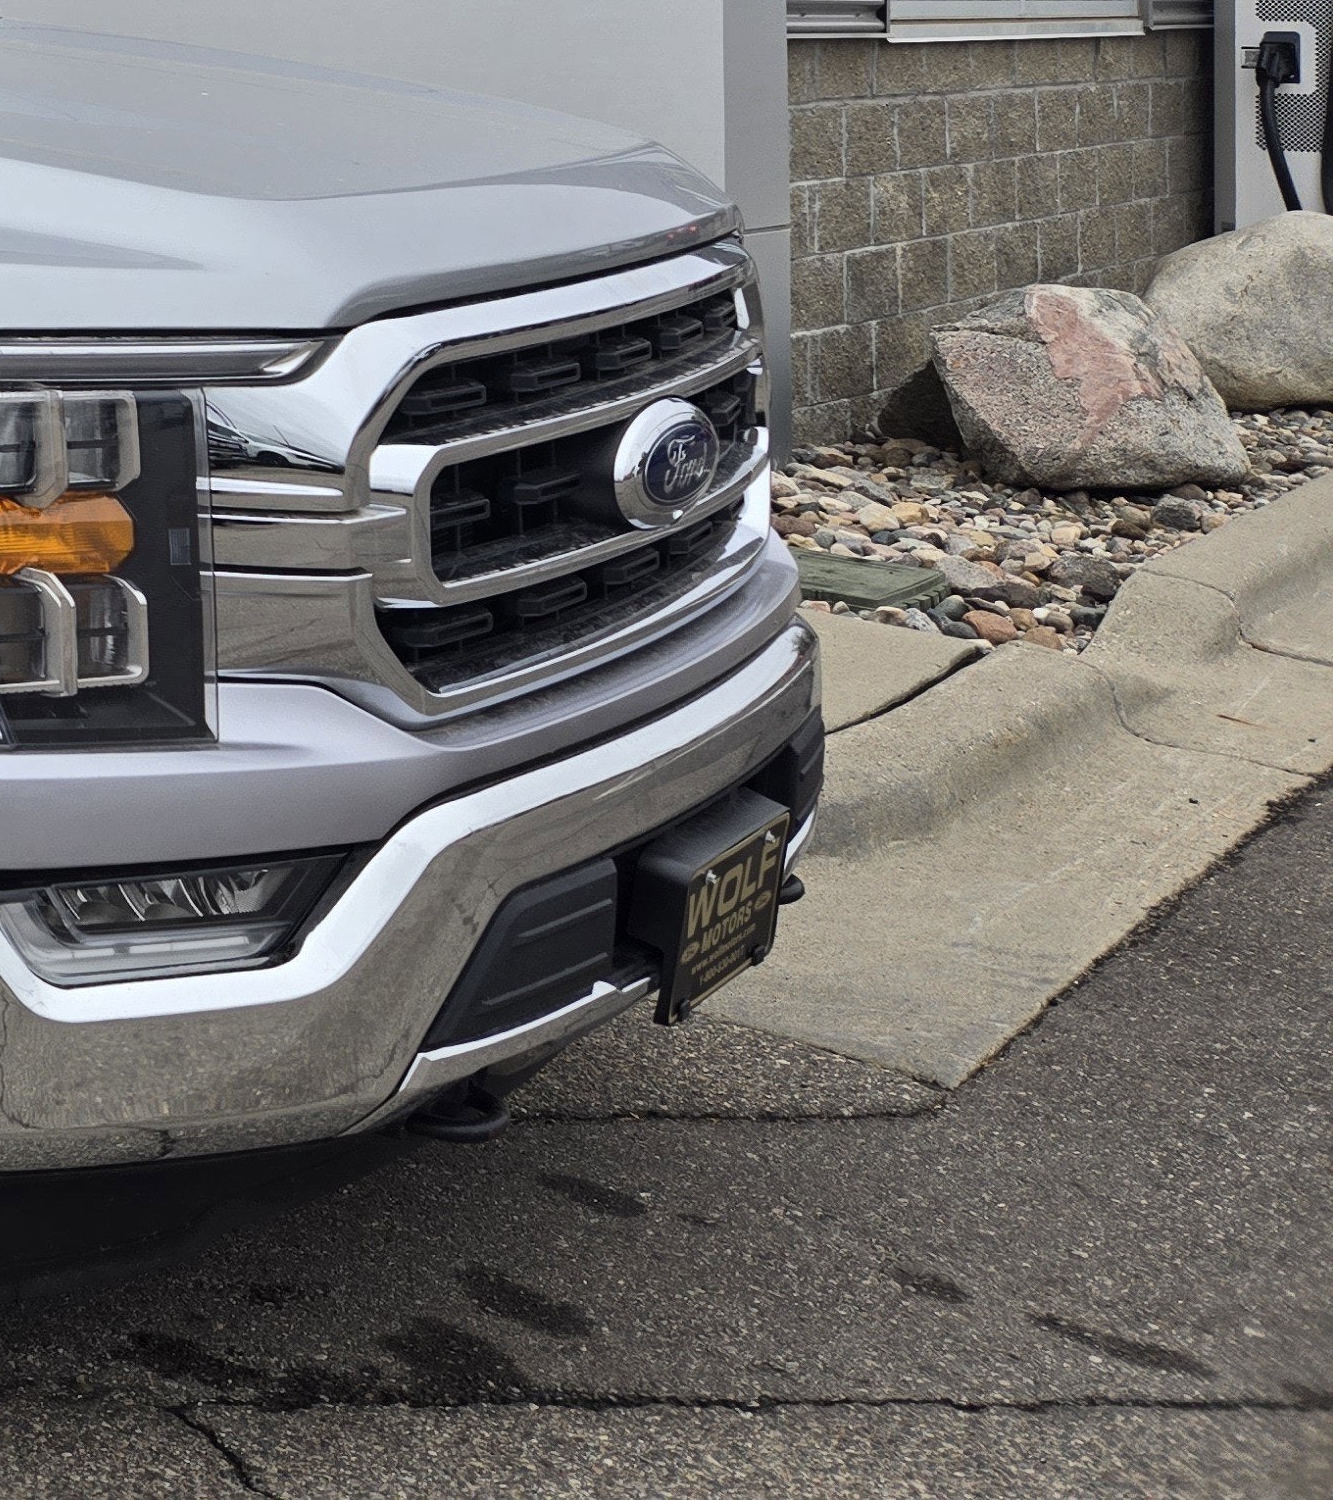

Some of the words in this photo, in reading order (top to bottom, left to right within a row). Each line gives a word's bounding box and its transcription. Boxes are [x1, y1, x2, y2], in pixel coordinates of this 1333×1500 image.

[664, 435, 712, 494] Ford
[687, 836, 781, 938] WOLF
[701, 902, 753, 954] MOTORS
